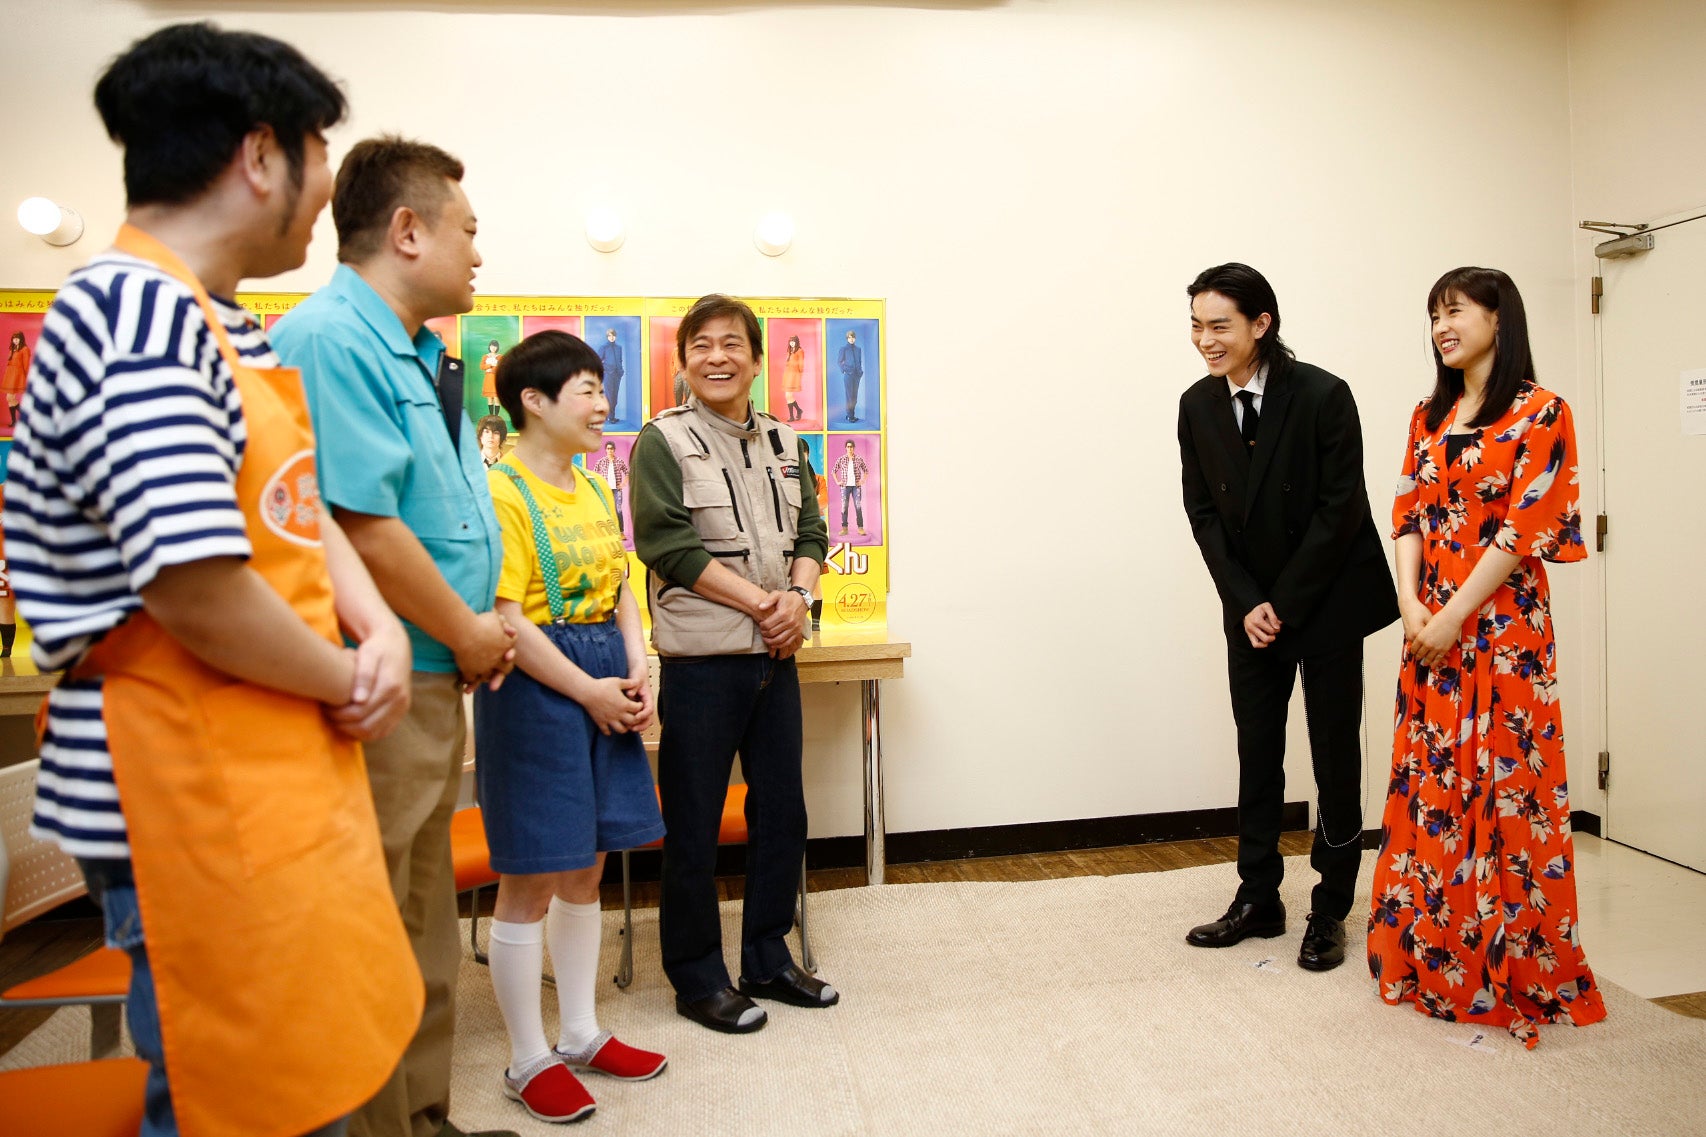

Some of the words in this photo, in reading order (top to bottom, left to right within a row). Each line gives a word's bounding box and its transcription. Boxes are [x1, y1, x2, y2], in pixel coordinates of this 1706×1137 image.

[553, 520, 620, 543] wanna
[554, 542, 606, 577] play
[824, 542, 868, 575] くん
[838, 593, 867, 608] 4.27
